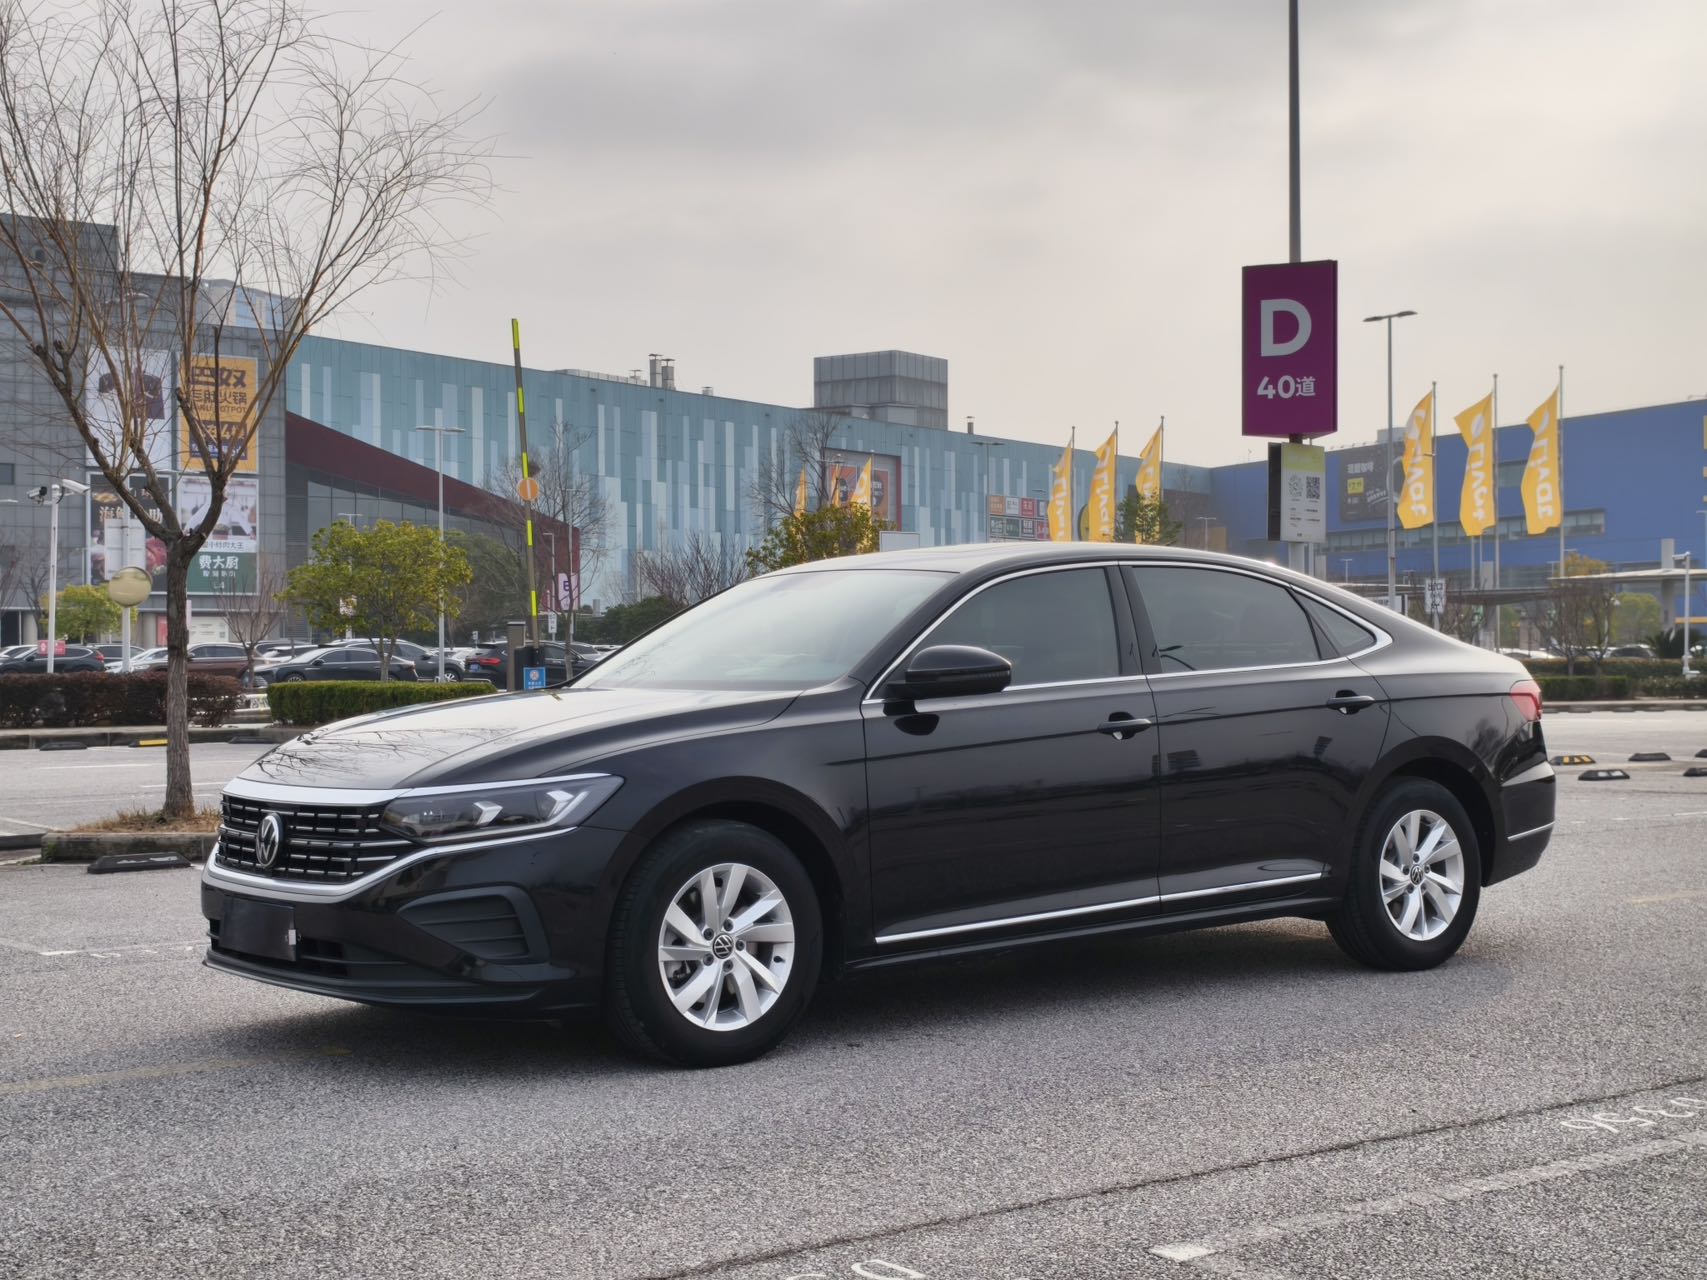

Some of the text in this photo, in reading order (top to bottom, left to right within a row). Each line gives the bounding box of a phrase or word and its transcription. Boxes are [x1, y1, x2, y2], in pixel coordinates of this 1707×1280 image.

[1260, 298, 1312, 357] D
[1256, 375, 1316, 399] 40道
[199, 555, 239, 570] 费大厨
